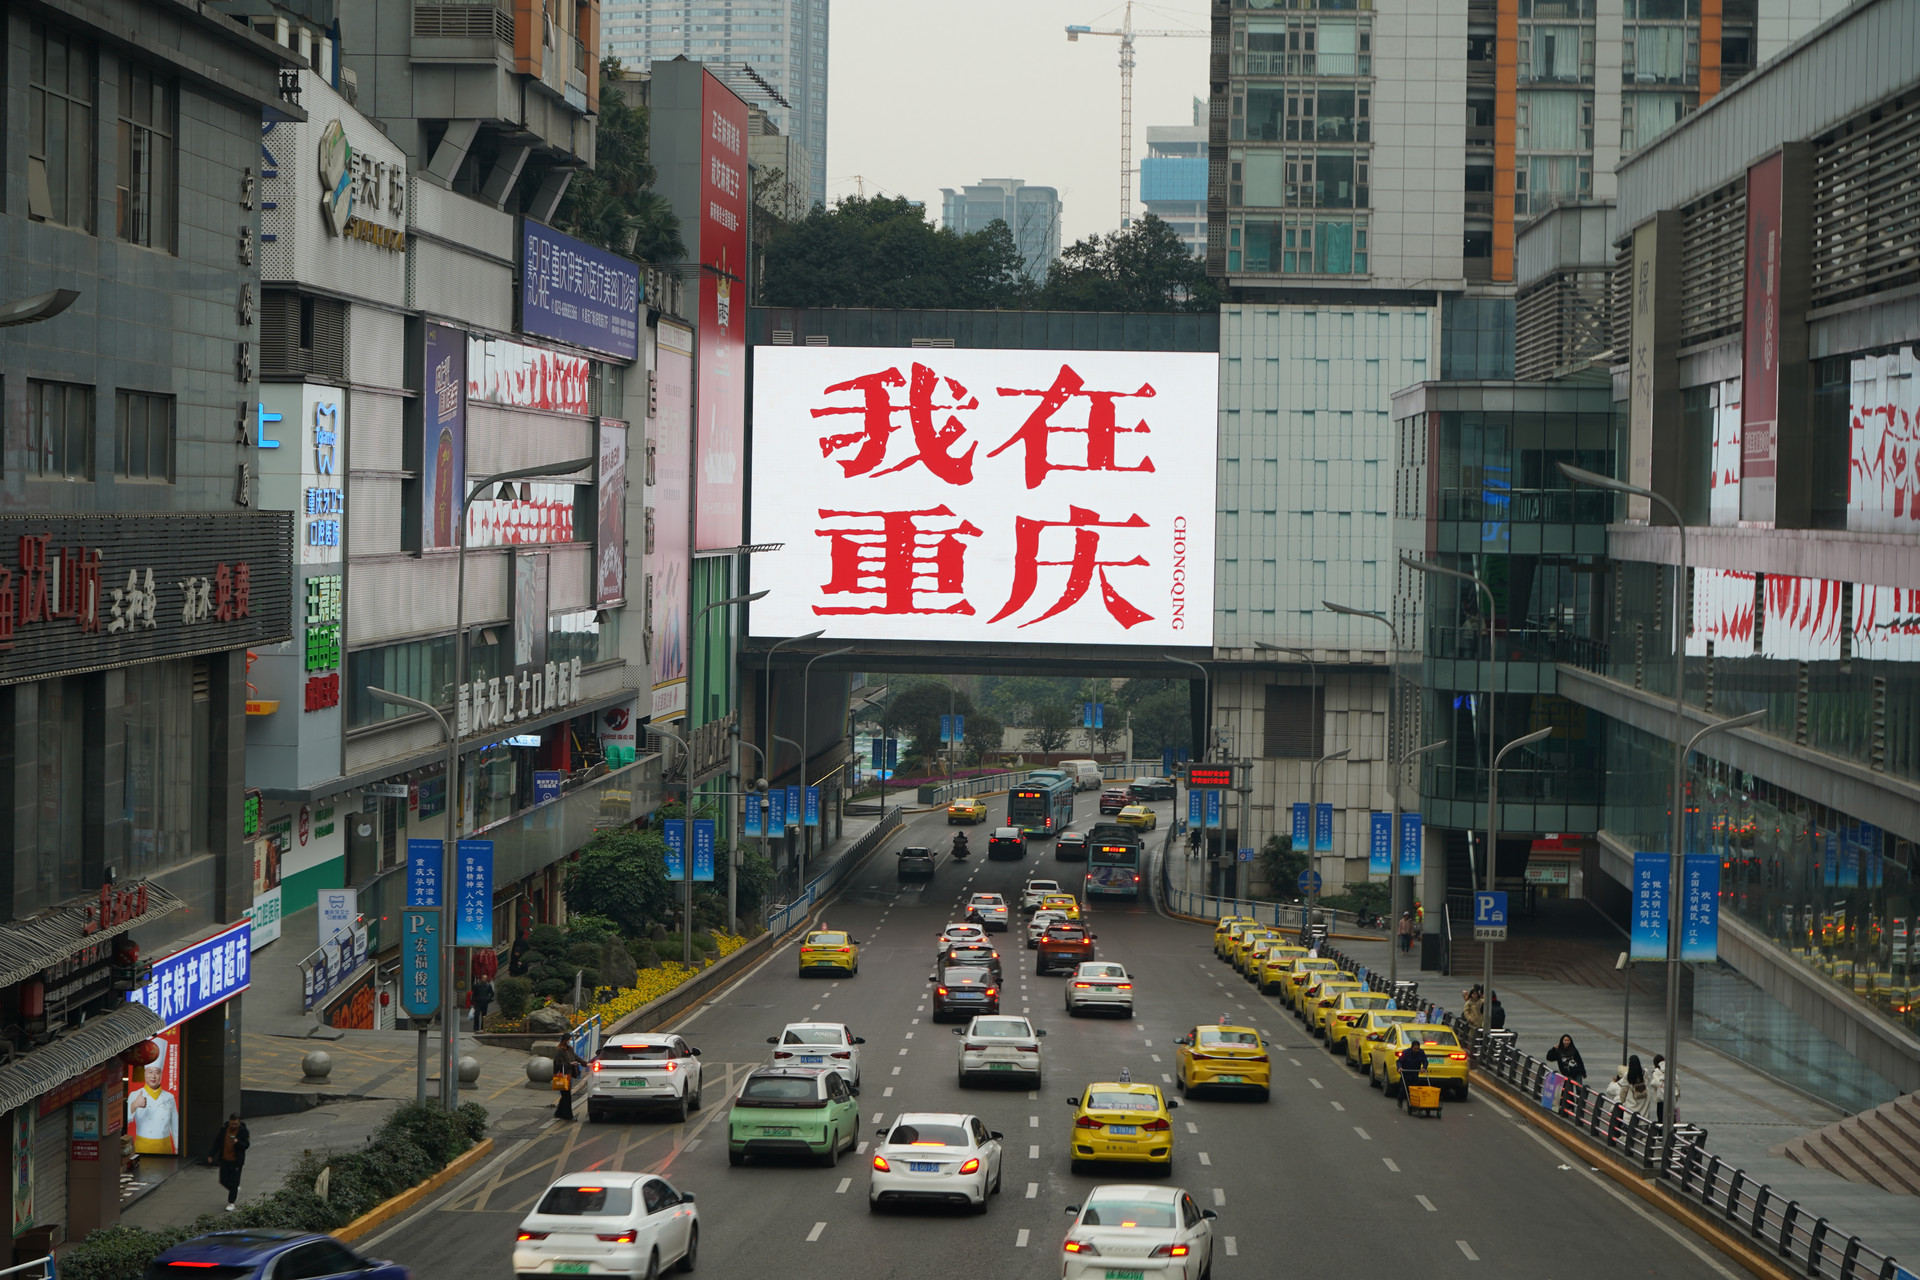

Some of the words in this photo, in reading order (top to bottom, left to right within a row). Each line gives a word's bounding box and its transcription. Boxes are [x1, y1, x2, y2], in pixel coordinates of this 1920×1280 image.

[551, 244, 636, 313] 重庆伊美尔医疗美容门诊部
[810, 361, 1156, 489] 我在
[308, 487, 345, 514] 重庆牙卫士
[310, 519, 340, 546] 口腔医院
[215, 561, 250, 622] 免费
[810, 504, 1155, 630] 重庆
[1171, 515, 1187, 630] CHONGQING
[458, 656, 582, 738] 重庆牙卫士口腔医院
[242, 897, 280, 931] 士口腔医院
[410, 915, 425, 934] P
[1477, 896, 1495, 921] P
[1640, 870, 1651, 928] 创全国文明城
[1650, 880, 1662, 938] 做文明江北人
[1689, 870, 1700, 945] 全国文明城区·江北
[1699, 891, 1711, 925] 欢迎您
[1476, 929, 1505, 938] 即停即走
[147, 934, 248, 1020] 重庆特产烟酒超市
[414, 937, 429, 1004] 宏福俊悦
